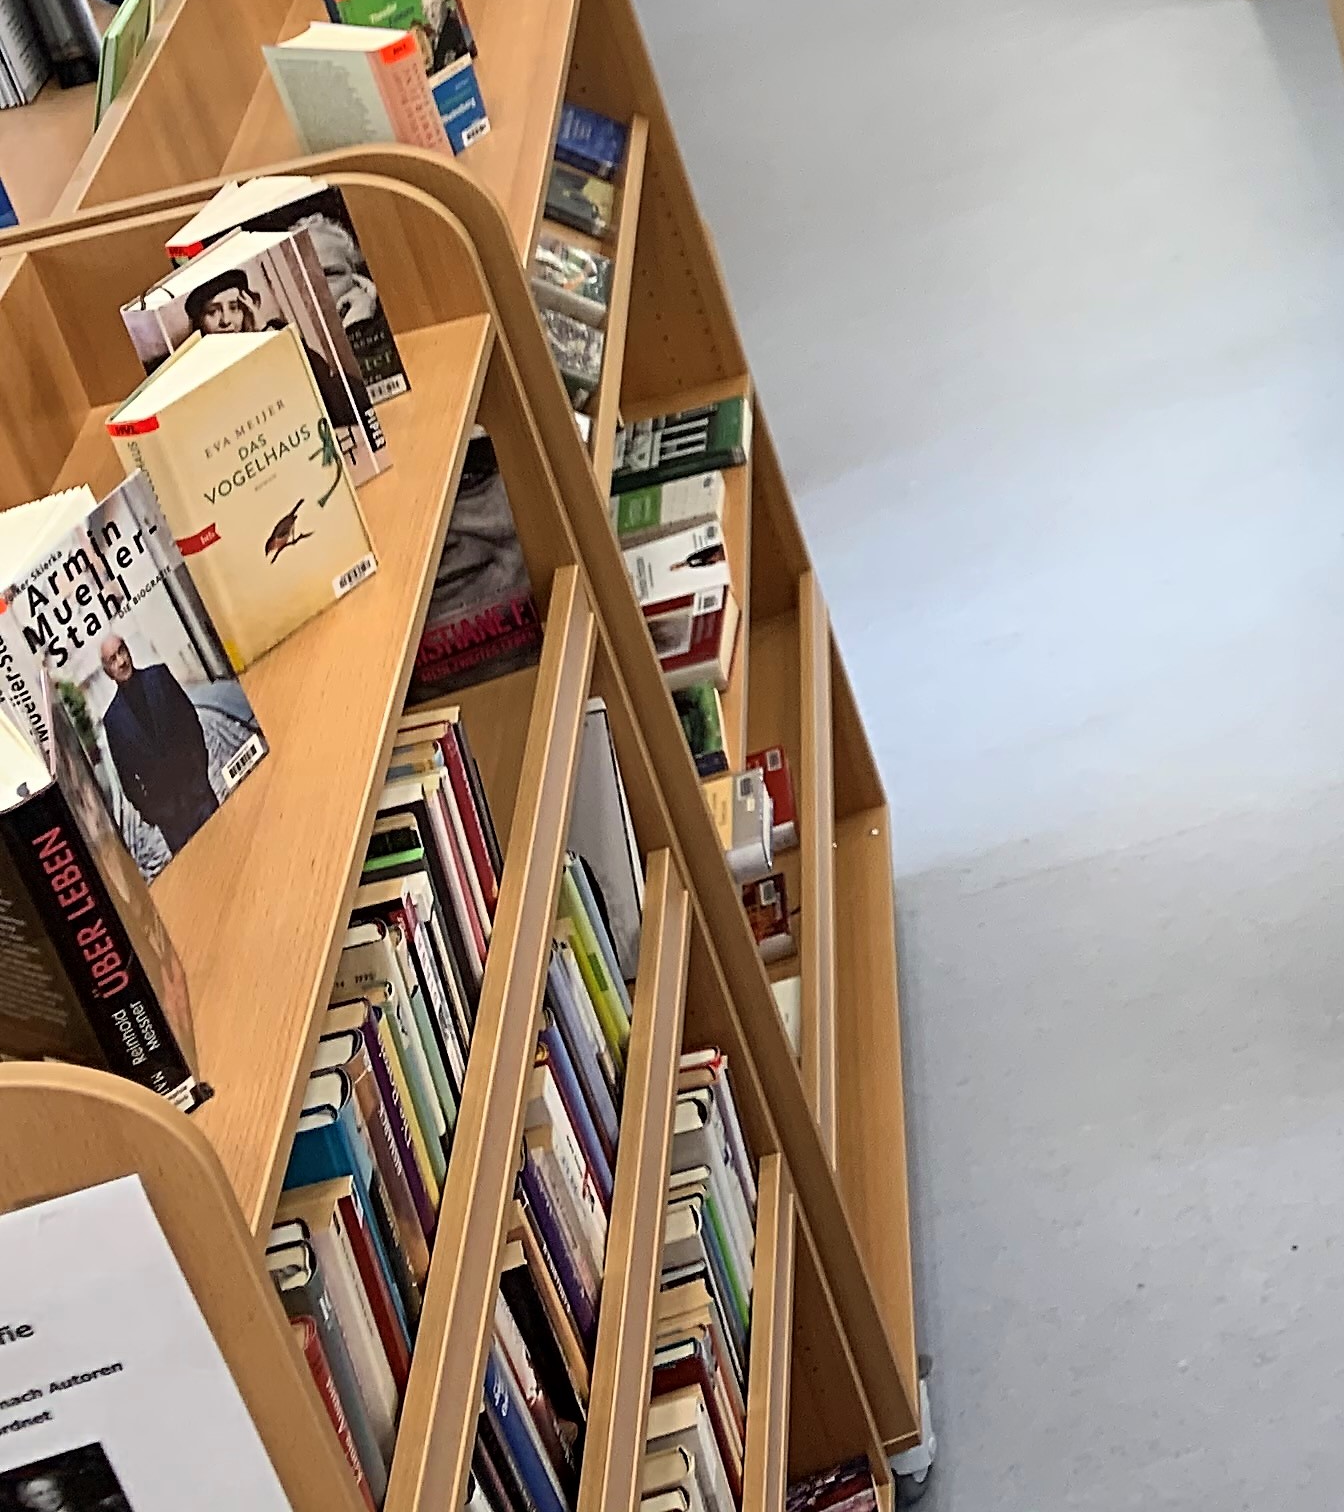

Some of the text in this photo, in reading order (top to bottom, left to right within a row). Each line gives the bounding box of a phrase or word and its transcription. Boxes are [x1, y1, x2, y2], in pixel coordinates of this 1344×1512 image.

[204, 399, 285, 459] EVA MEIJER
[238, 434, 268, 460] DAS
[364, 407, 386, 450] PIPER
[202, 426, 311, 505] VOGELHAUS
[22, 524, 159, 655] Mueller-
[27, 518, 122, 618] Armin
[117, 566, 173, 620] DIE BIOGRAFIE
[47, 574, 133, 668] Stahl
[31, 825, 131, 999] ÜBER LEBEN
[111, 1009, 148, 1067] Reinhold
[129, 1000, 161, 1052] Messner
[49, 1361, 123, 1394] Autoren
